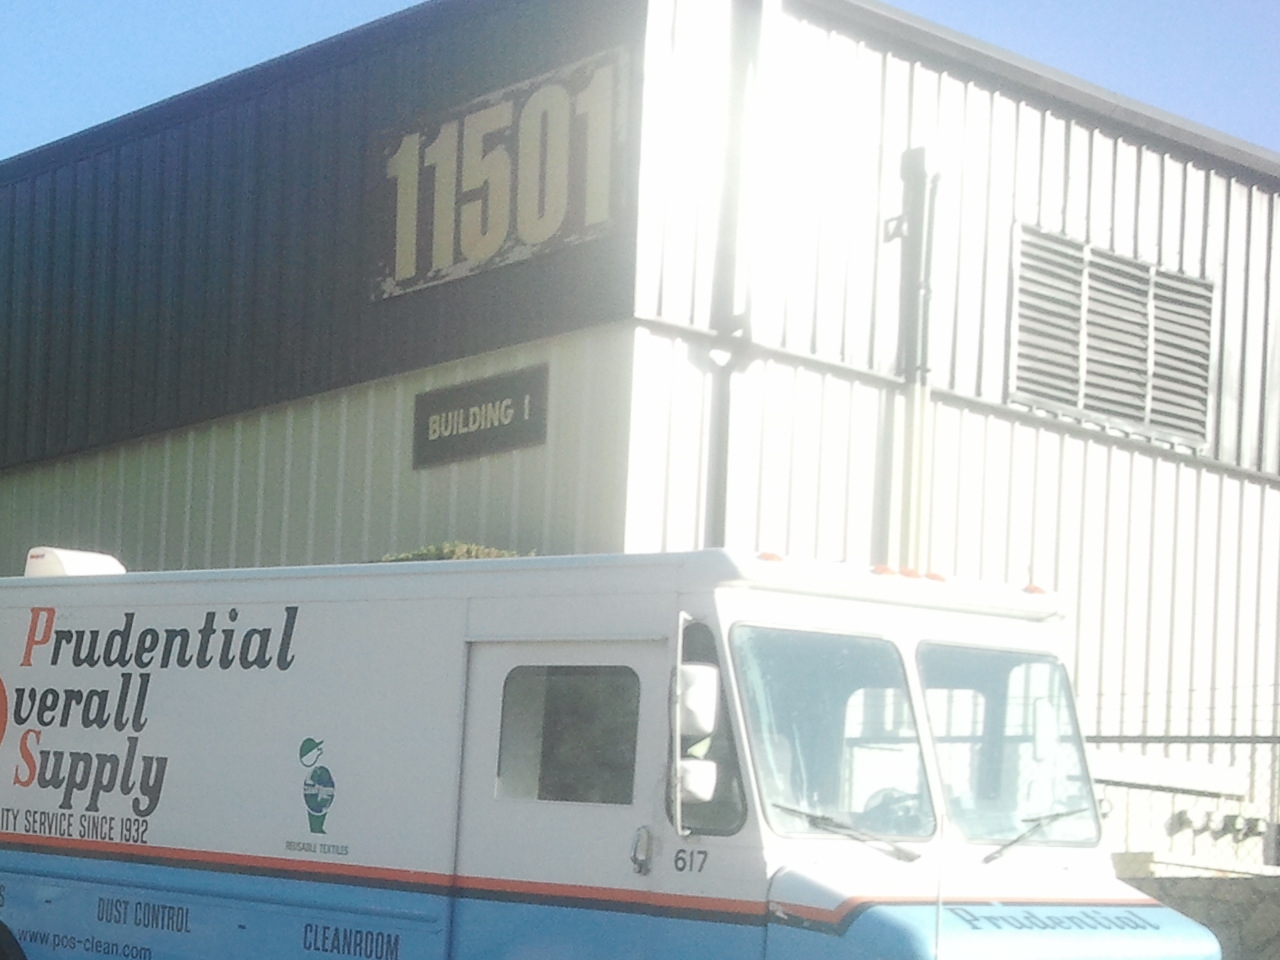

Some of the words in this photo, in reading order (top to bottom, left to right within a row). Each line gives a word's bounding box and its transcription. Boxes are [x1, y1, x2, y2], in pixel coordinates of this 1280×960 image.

[387, 65, 612, 282] 11501
[428, 399, 514, 440] BUILDING
[20, 606, 299, 671] Prudential
[13, 729, 168, 818] Supply
[24, 810, 74, 838] SERVICE
[78, 817, 115, 841] SINCE
[119, 817, 149, 844] 1932
[319, 843, 349, 856] TEXTILES
[674, 849, 708, 873] 617
[97, 897, 128, 925] DUST
[134, 901, 191, 933] CONTROL
[303, 923, 400, 960] CLEANROOM
[945, 907, 1160, 931] Prudential
